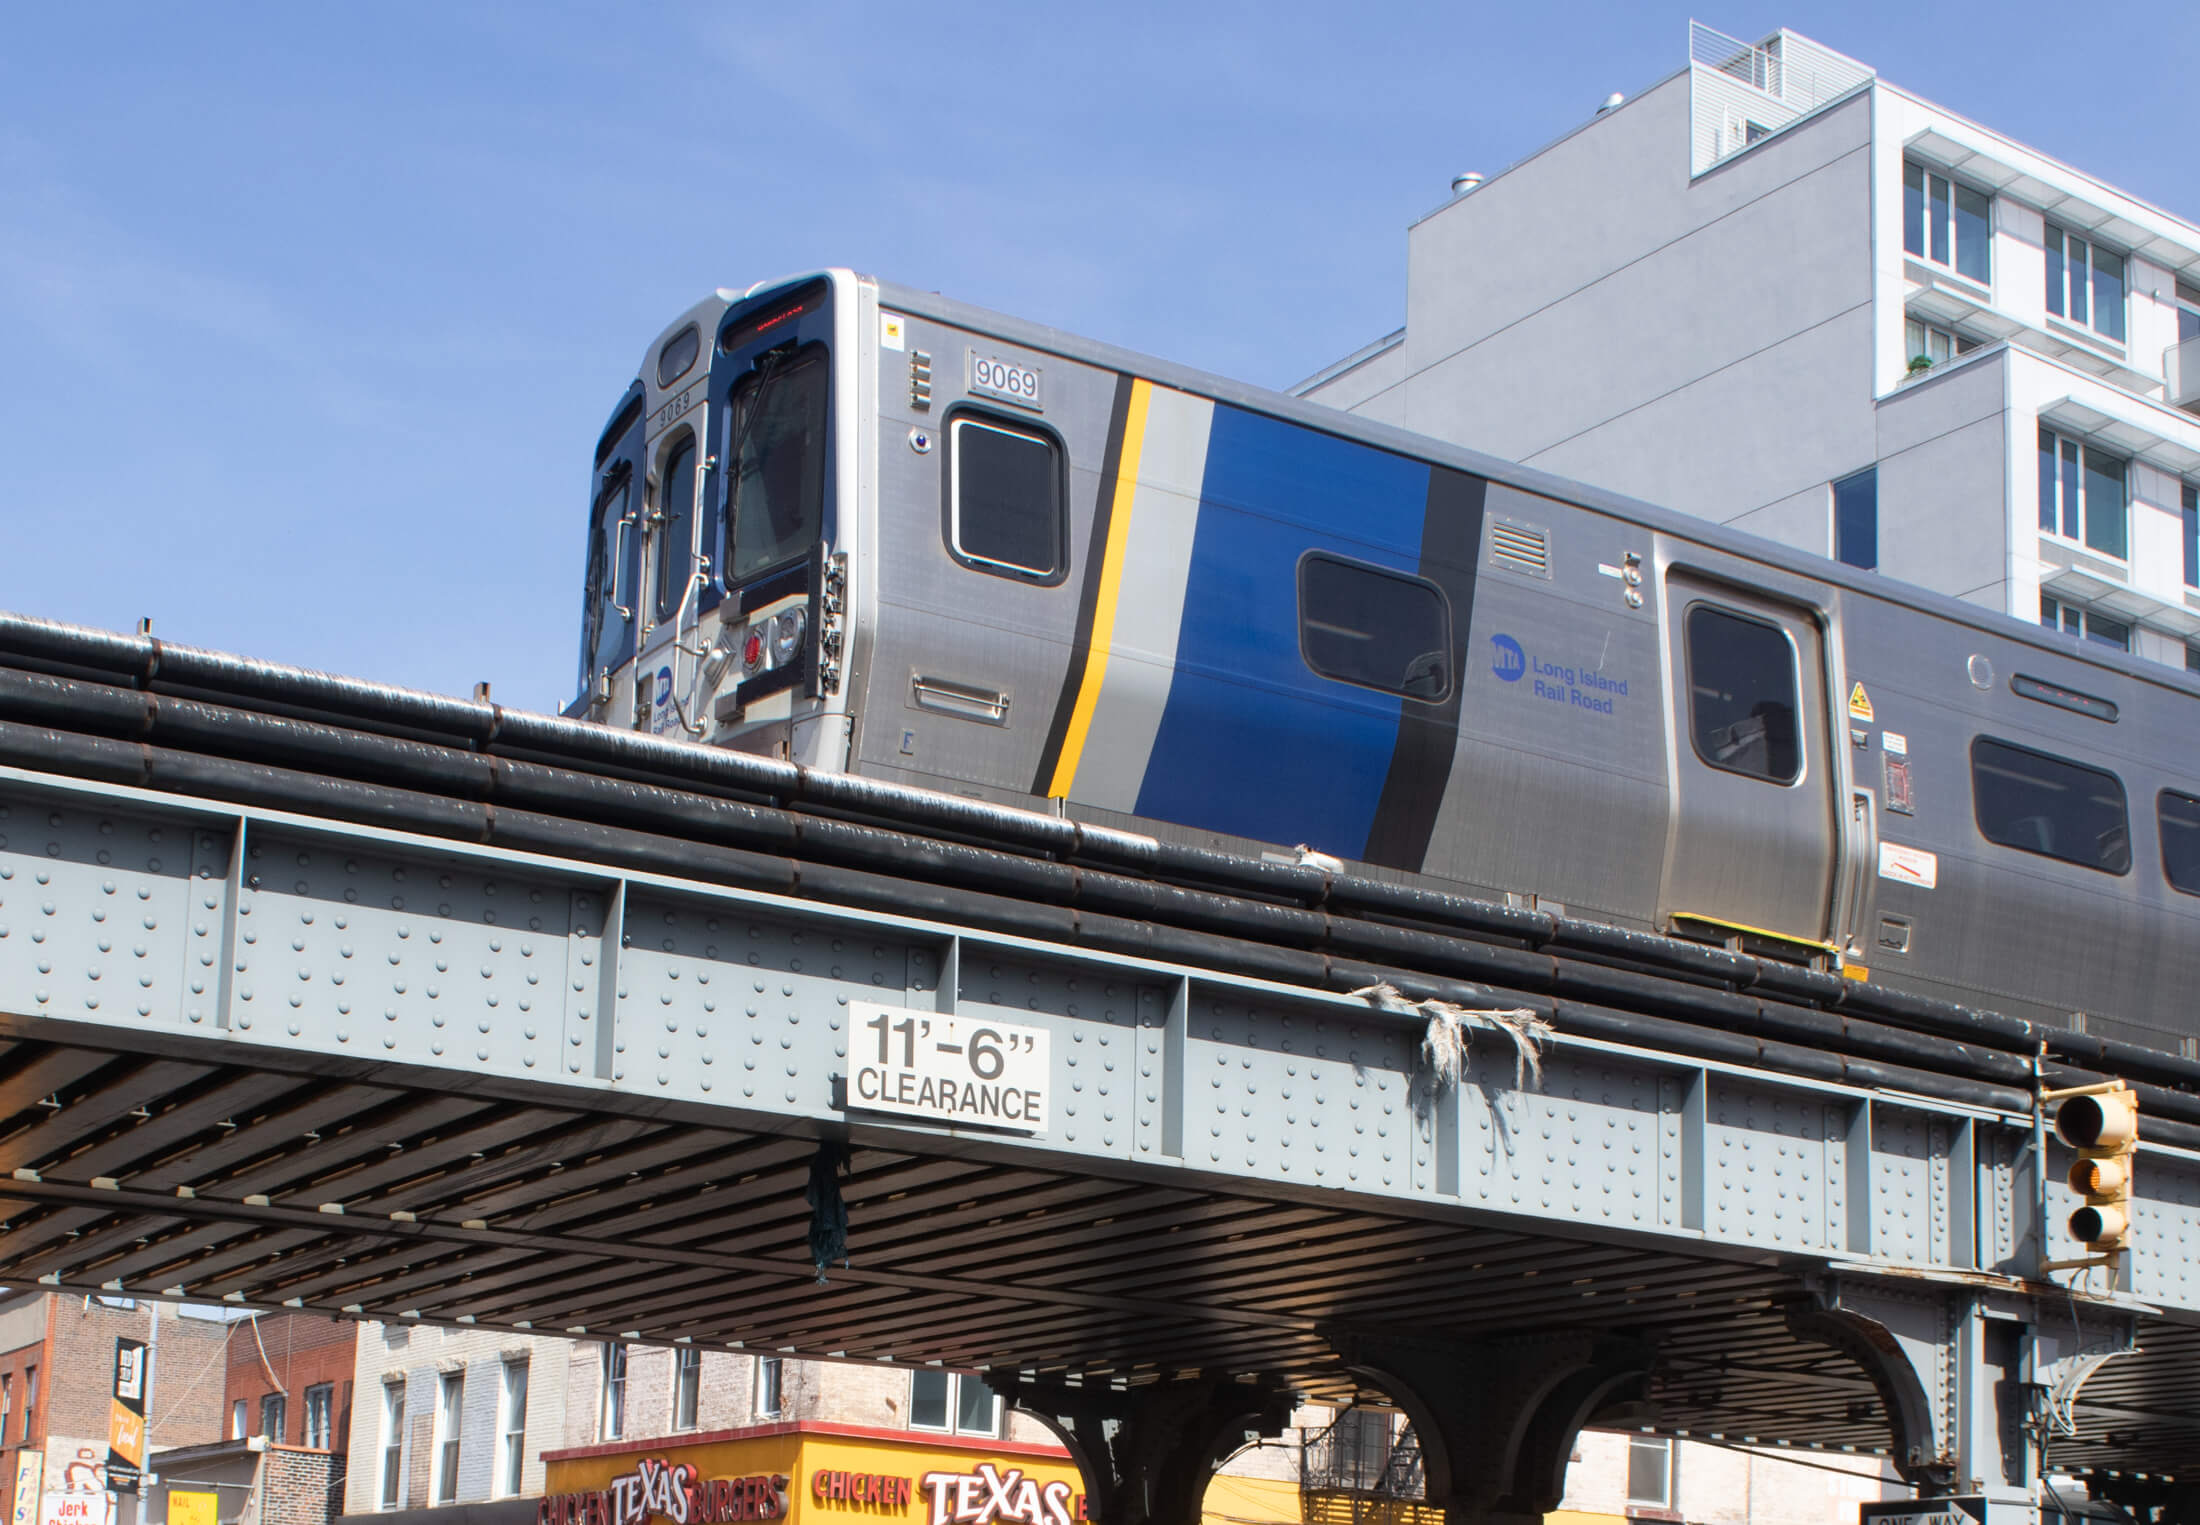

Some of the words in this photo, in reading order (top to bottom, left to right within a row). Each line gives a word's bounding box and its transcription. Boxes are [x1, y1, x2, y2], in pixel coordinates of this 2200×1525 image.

[976, 359, 1036, 397] 9069
[660, 391, 690, 427] 9069
[1533, 655, 1575, 686] Long
[1579, 668, 1628, 696] Island
[1534, 679, 1565, 703] Rail
[1570, 688, 1613, 715] Road
[857, 1066, 1041, 1122] CLEARANCE
[58, 1500, 88, 1517] Jerk
[610, 1459, 691, 1525] TEXAS
[690, 1475, 784, 1524] BURGERS
[814, 1468, 913, 1505] CHICKEN
[922, 1463, 1071, 1525] TEXAS
